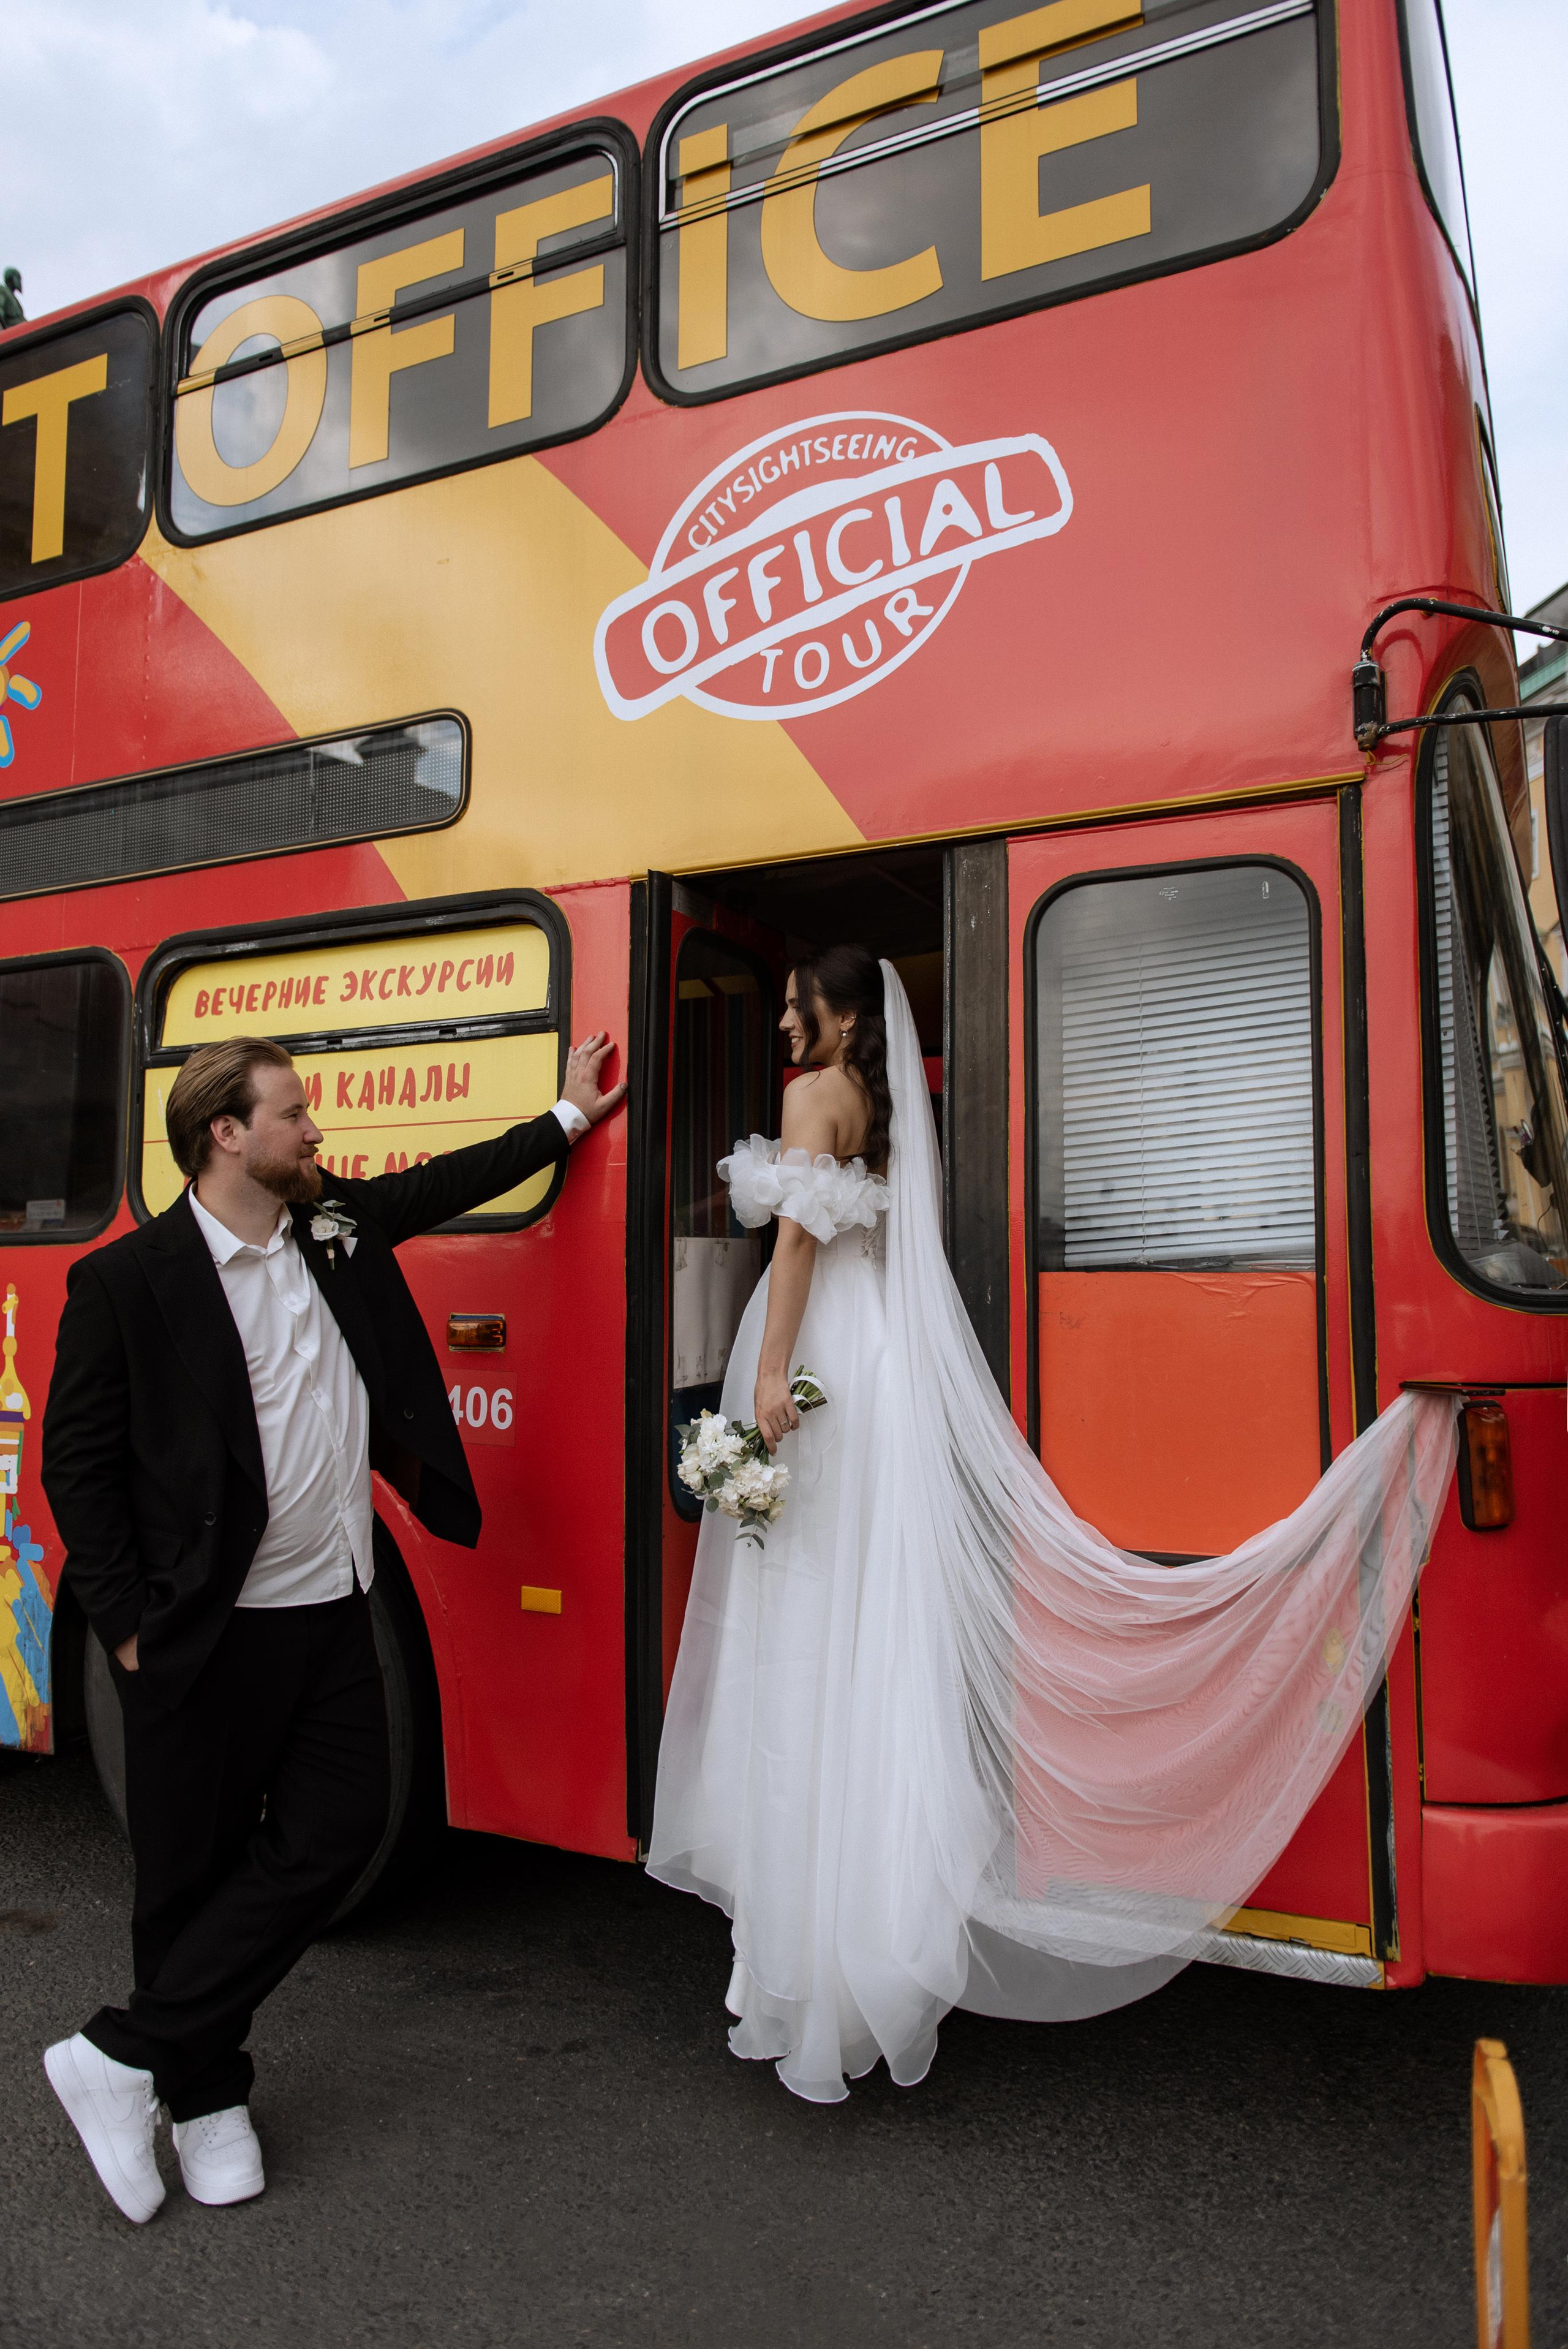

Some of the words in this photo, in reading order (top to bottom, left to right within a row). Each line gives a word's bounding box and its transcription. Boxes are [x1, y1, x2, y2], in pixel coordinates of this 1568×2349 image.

[2, 353, 108, 564] T
[687, 433, 918, 551] CITYSIGHTSEEING
[641, 462, 1036, 675] OFFICIAL
[760, 588, 934, 693] TOUR
[194, 975, 330, 1018] ВЕЧЕРНИЕ
[339, 951, 514, 1002] ЭКСКУРСИИ
[336, 1062, 470, 1111] КАНАЛЫ
[448, 1385, 513, 1430] 406
